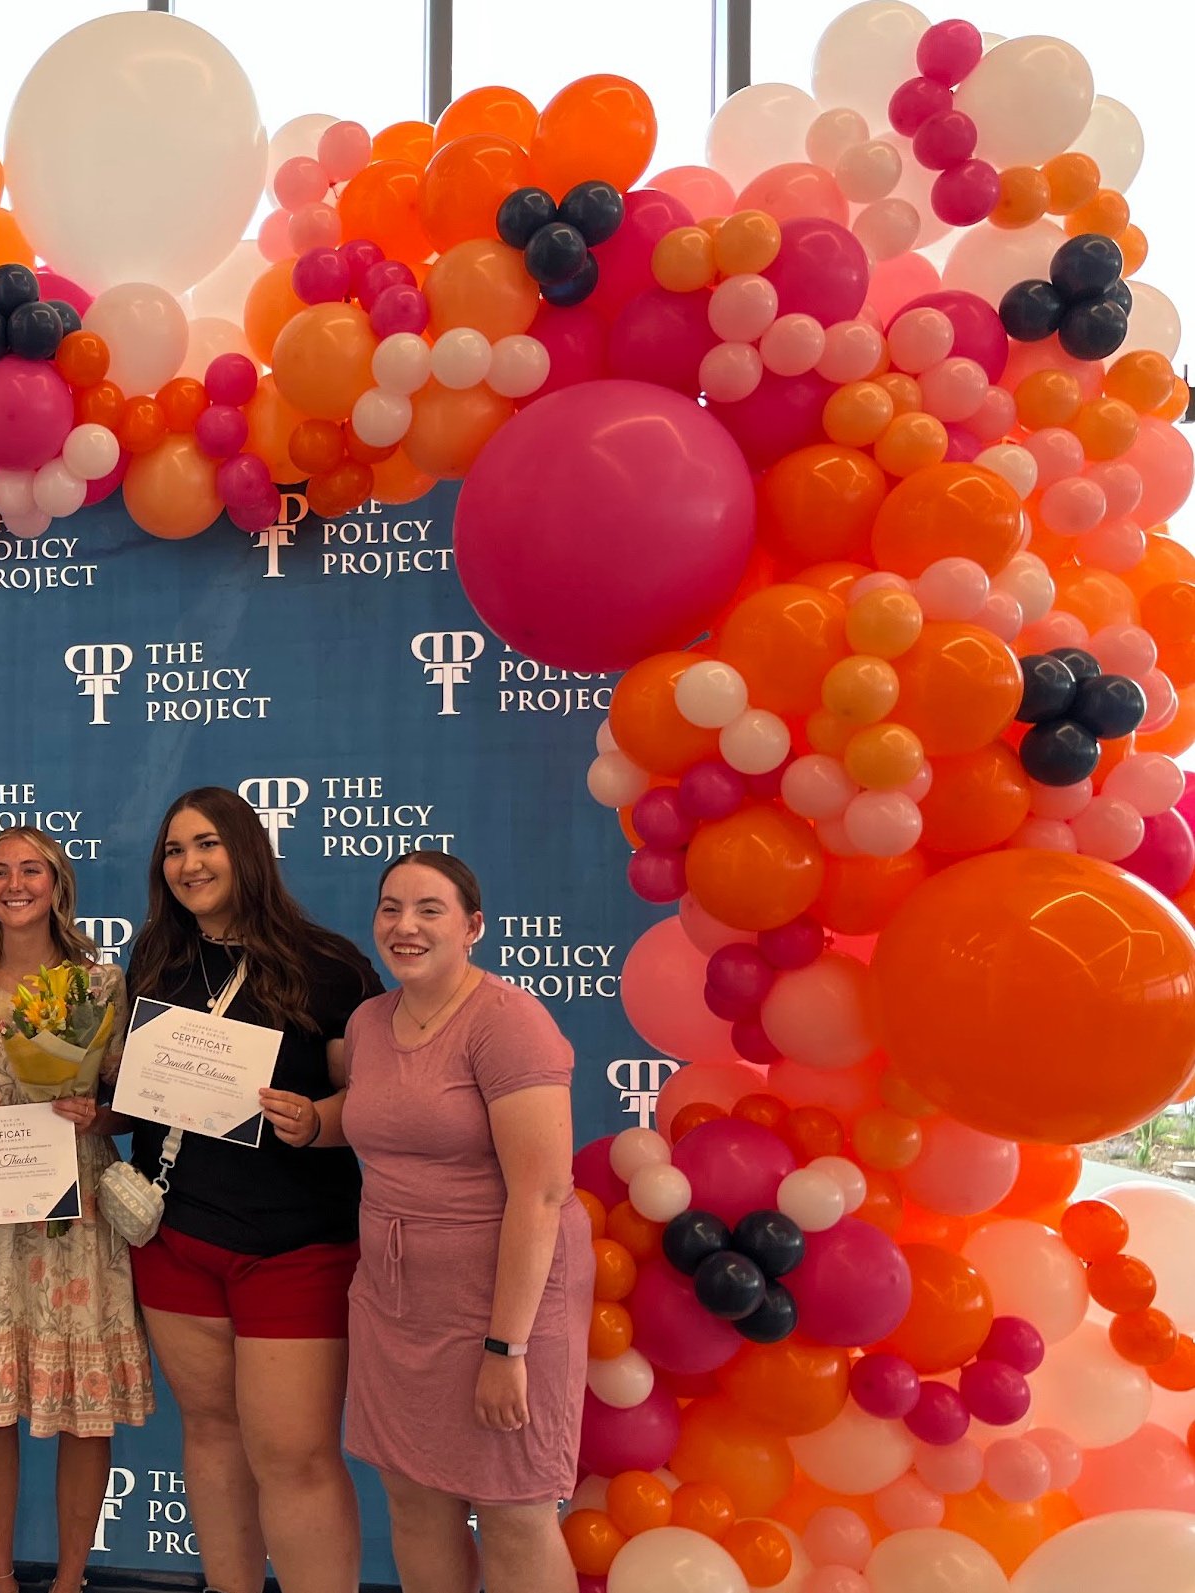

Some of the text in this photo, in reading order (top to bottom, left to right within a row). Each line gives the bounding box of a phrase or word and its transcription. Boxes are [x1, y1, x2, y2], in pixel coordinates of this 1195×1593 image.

[322, 519, 433, 546] POLICY
[322, 548, 454, 580] PROJECT
[145, 641, 204, 665] THE
[145, 668, 251, 693] POLICY
[145, 697, 271, 726] PROJECT
[498, 687, 613, 717] PROJEC
[321, 776, 383, 799] THE
[322, 804, 434, 828] POLICY
[322, 833, 455, 862] PROJECT
[498, 915, 562, 938] THE
[499, 945, 616, 967] POLICY
[171, 1031, 234, 1054] CERTIFICATE
[154, 1051, 195, 1073] Danielle
[196, 1062, 237, 1083] Colosimo
[0, 1154, 38, 1168] Thacker
[147, 1470, 186, 1494] TH
